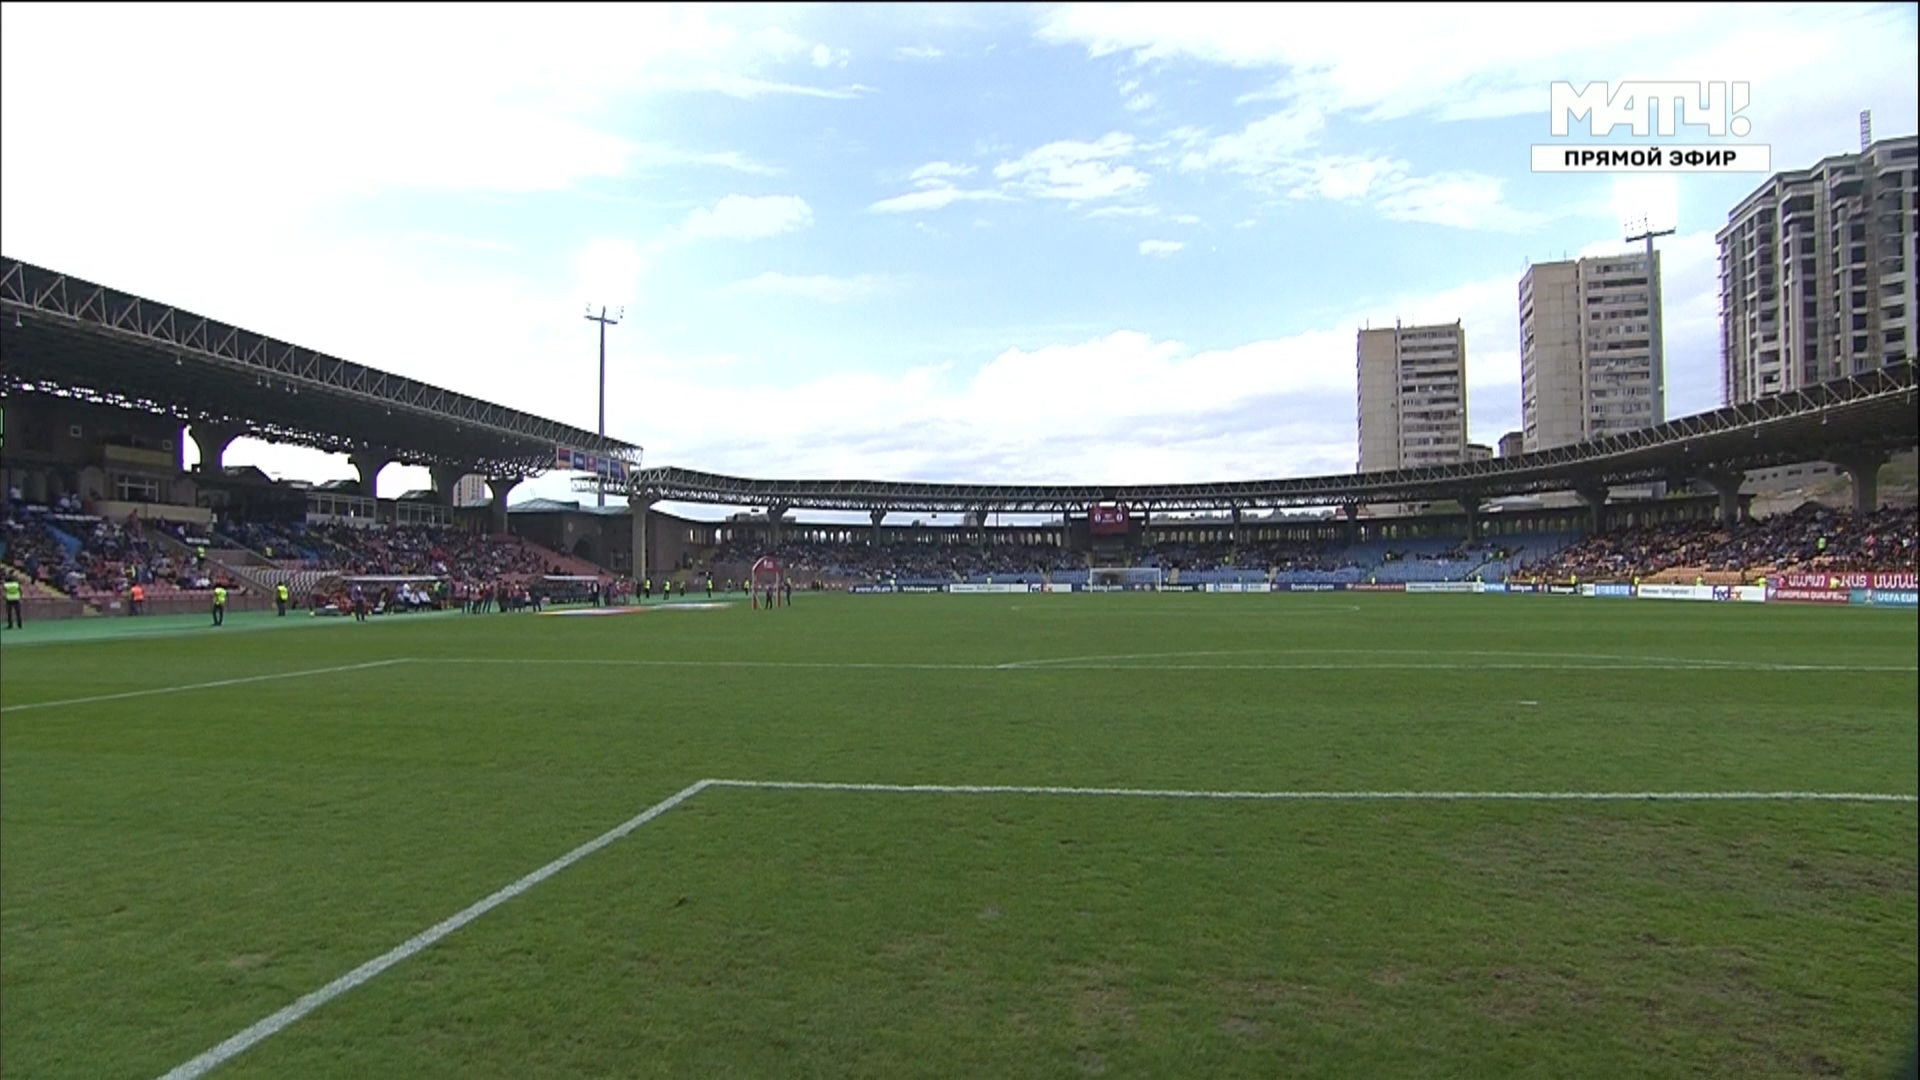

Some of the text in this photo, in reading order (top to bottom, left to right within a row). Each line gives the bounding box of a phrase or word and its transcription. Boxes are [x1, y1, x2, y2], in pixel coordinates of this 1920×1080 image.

[1712, 586, 1742, 600] FedEx
[1777, 590, 1810, 599] EUROPEAN
[1877, 592, 1900, 602] UEFA
